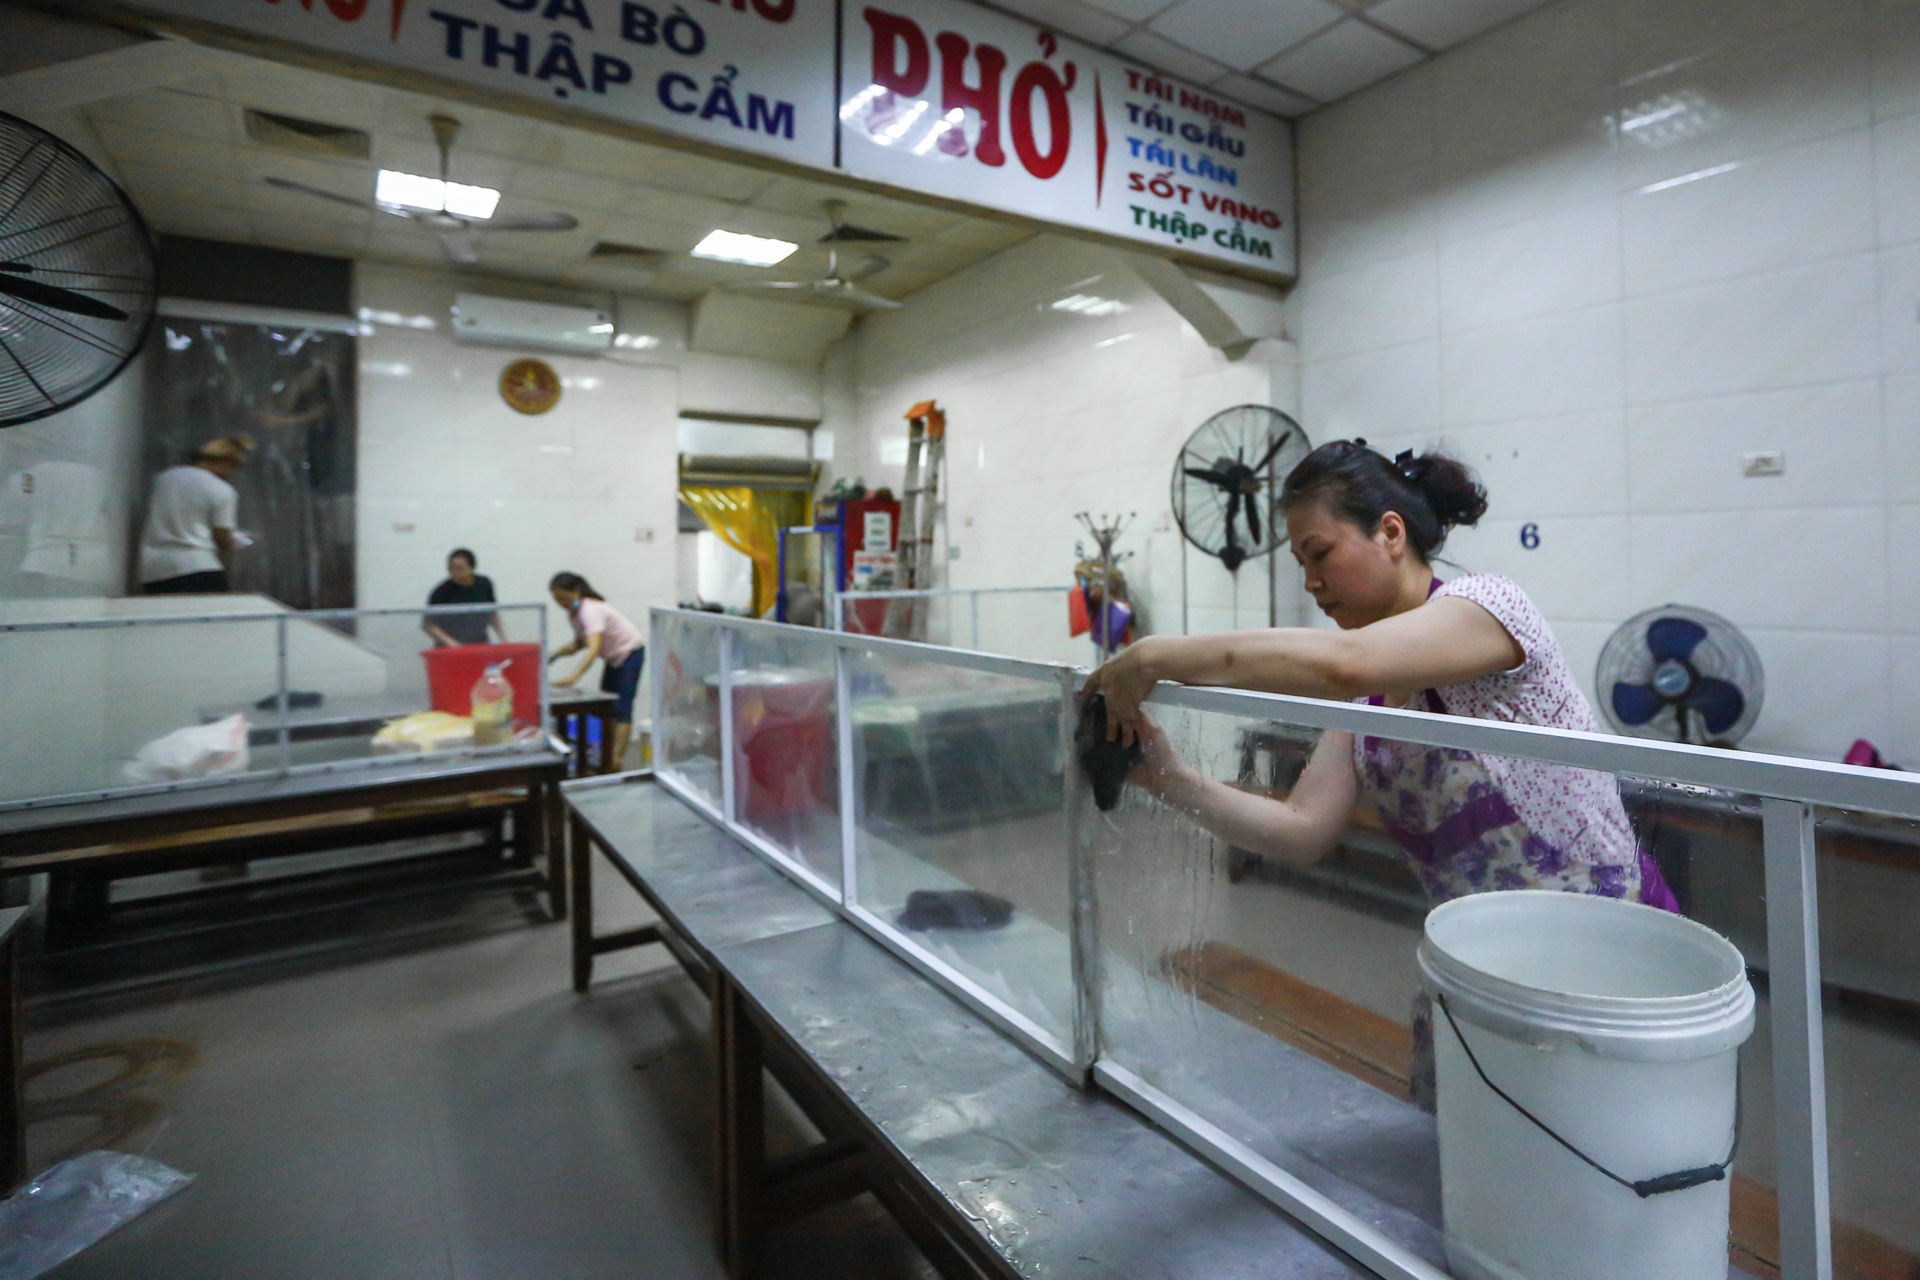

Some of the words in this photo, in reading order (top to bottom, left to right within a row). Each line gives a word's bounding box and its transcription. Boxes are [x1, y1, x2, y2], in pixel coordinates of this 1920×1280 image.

[621, 1, 706, 56] BÒ
[429, 10, 632, 98] THẬP
[656, 64, 797, 140] CẨM
[863, 6, 1077, 180] PHỞ
[1125, 101, 1174, 135] TÁI
[1126, 136, 1176, 169] TÁI
[1128, 171, 1193, 205] SỐT
[1200, 191, 1282, 230] VANG
[1129, 204, 1208, 244] THẬP
[1519, 523, 1541, 550] 6
